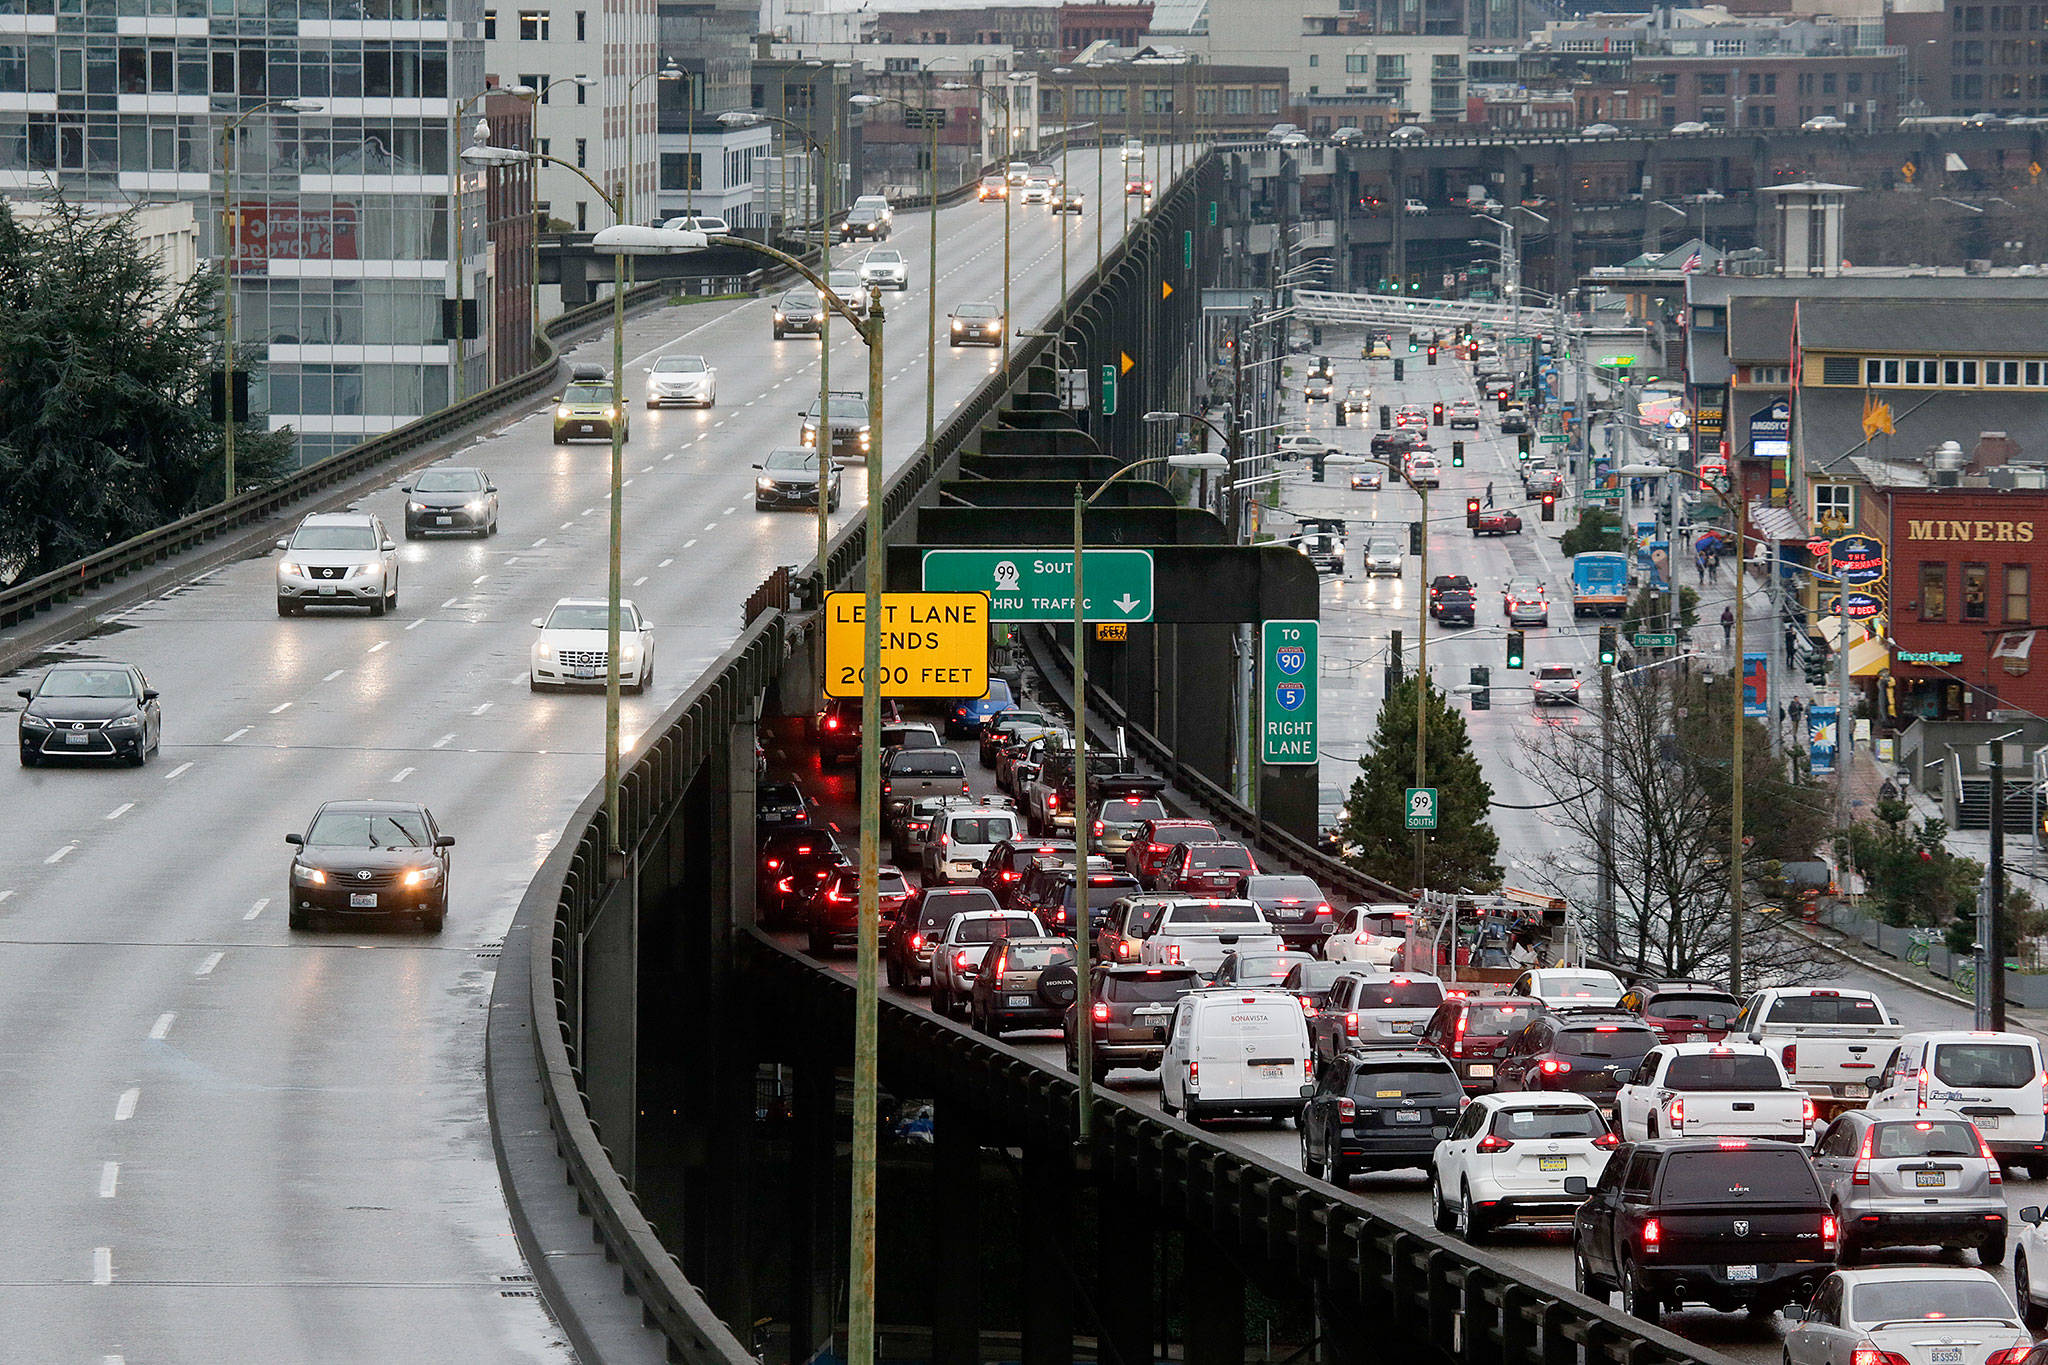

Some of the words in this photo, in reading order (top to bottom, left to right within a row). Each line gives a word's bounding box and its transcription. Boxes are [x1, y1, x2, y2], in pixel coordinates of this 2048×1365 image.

[1908, 520, 2034, 543] MINERS
[1847, 553, 1867, 561] THE
[998, 565, 1015, 580] 99
[1031, 597, 1092, 610] TRAFFC
[1857, 604, 1878, 616] DECK
[837, 605, 898, 623] LET
[910, 605, 977, 624] LANE
[1282, 628, 1301, 641] TO
[1638, 635, 1661, 646] Union
[1663, 635, 1673, 645] St
[1281, 654, 1301, 669] 90
[921, 668, 973, 683] FEET
[1286, 690, 1296, 705] 5
[1267, 721, 1313, 736] RIGHT
[1268, 740, 1312, 755] LANE
[1414, 796, 1429, 808] 99
[1408, 818, 1434, 827] SOUTH
[1045, 979, 1074, 987] HONDA
